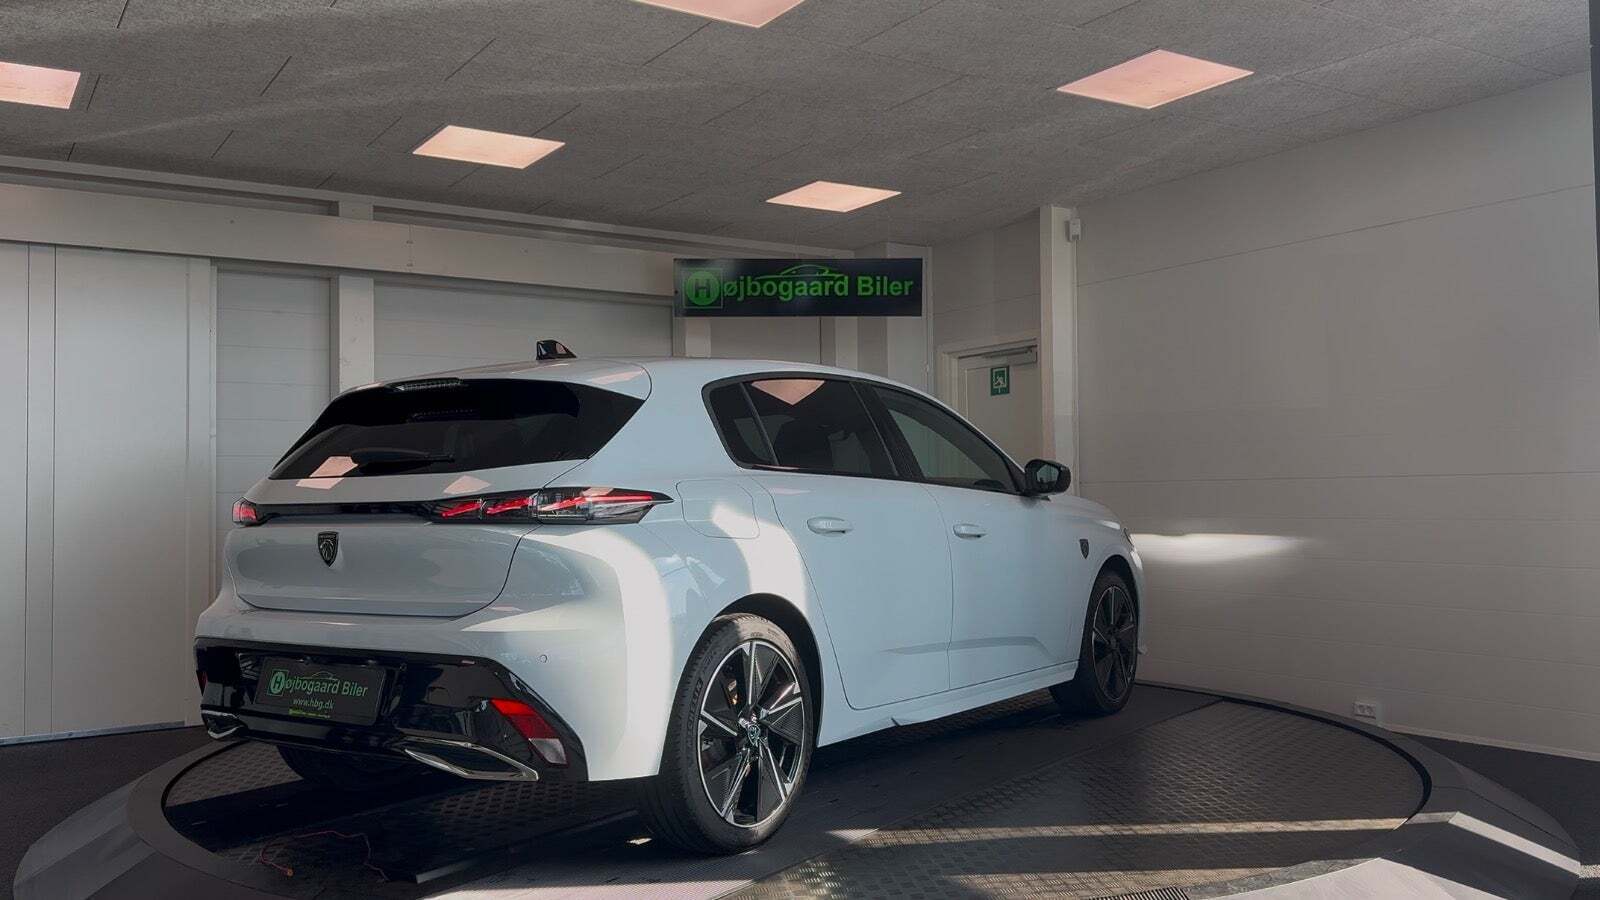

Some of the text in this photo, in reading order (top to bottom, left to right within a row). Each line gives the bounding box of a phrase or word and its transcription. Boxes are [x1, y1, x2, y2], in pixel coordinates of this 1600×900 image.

[685, 271, 914, 306] Højbogaard Biler
[270, 671, 369, 697] Højbogaard Biler
[293, 697, 335, 710] www.hbg.dk
